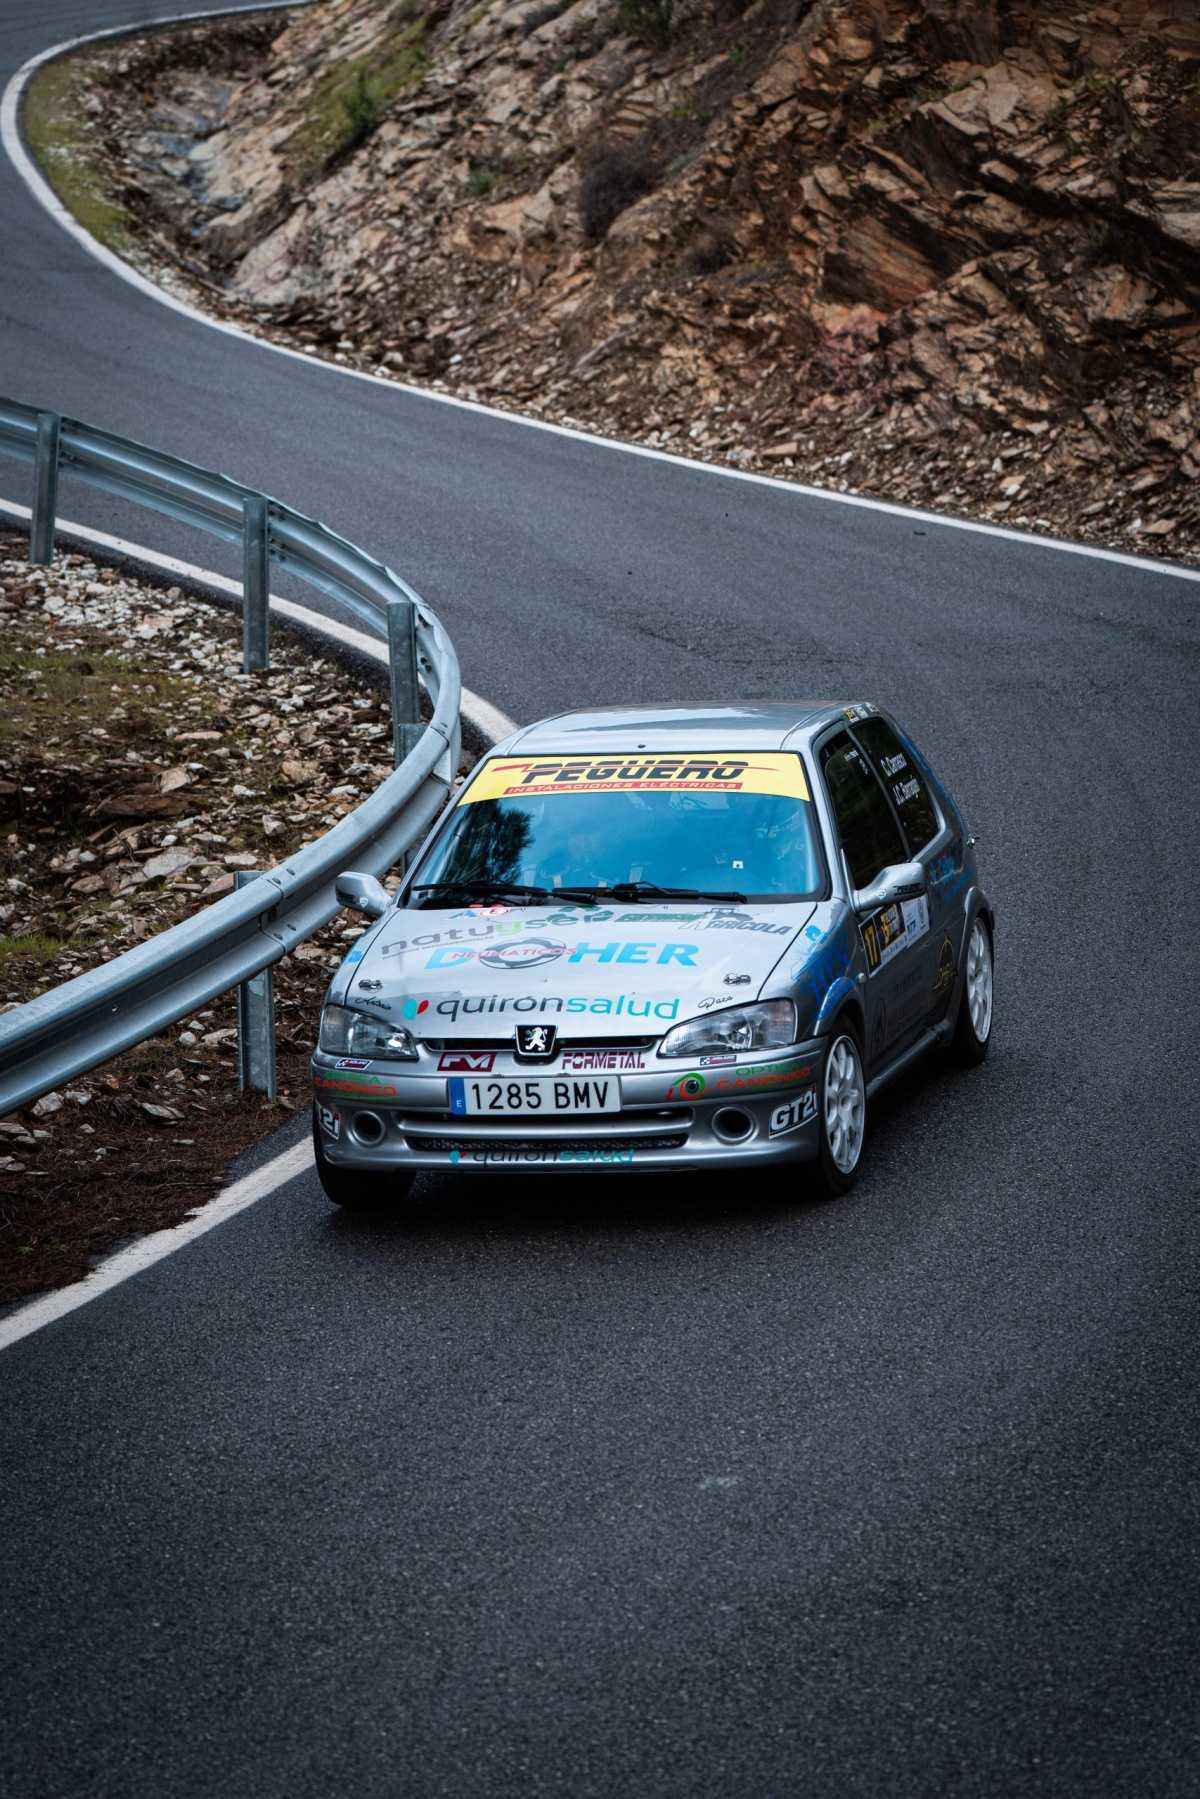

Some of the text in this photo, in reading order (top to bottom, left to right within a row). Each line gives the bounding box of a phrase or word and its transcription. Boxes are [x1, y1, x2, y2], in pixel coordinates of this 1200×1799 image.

[521, 760, 749, 784] PEGUERO
[507, 781, 633, 794] INSTALACIONES
[561, 1051, 646, 1070] FORMETAL
[456, 1099, 463, 1108] E
[472, 1081, 609, 1110] 1285 BMV
